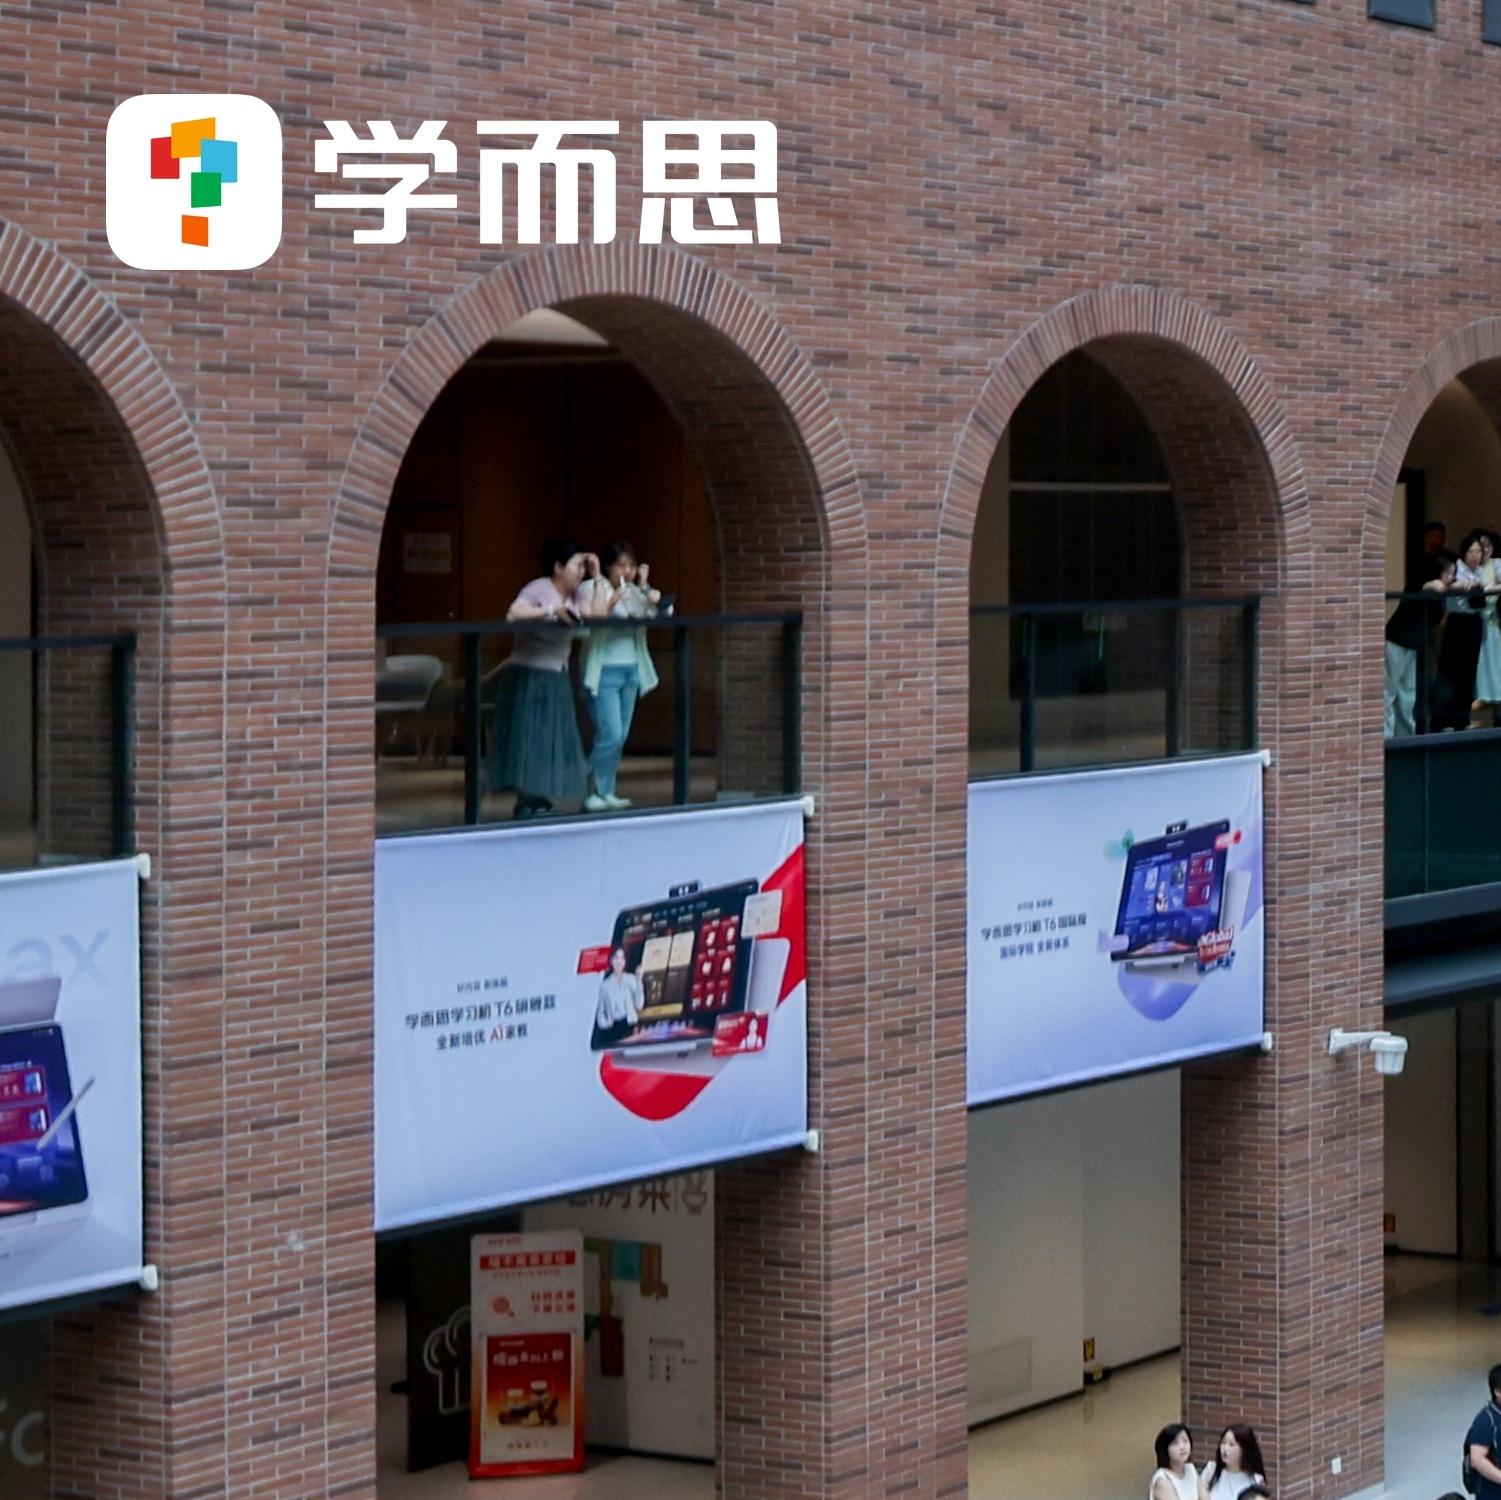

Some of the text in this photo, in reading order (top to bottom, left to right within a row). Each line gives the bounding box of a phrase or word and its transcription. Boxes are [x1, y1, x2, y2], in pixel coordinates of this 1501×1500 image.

[405, 1004, 492, 1029] 学而思学习机
